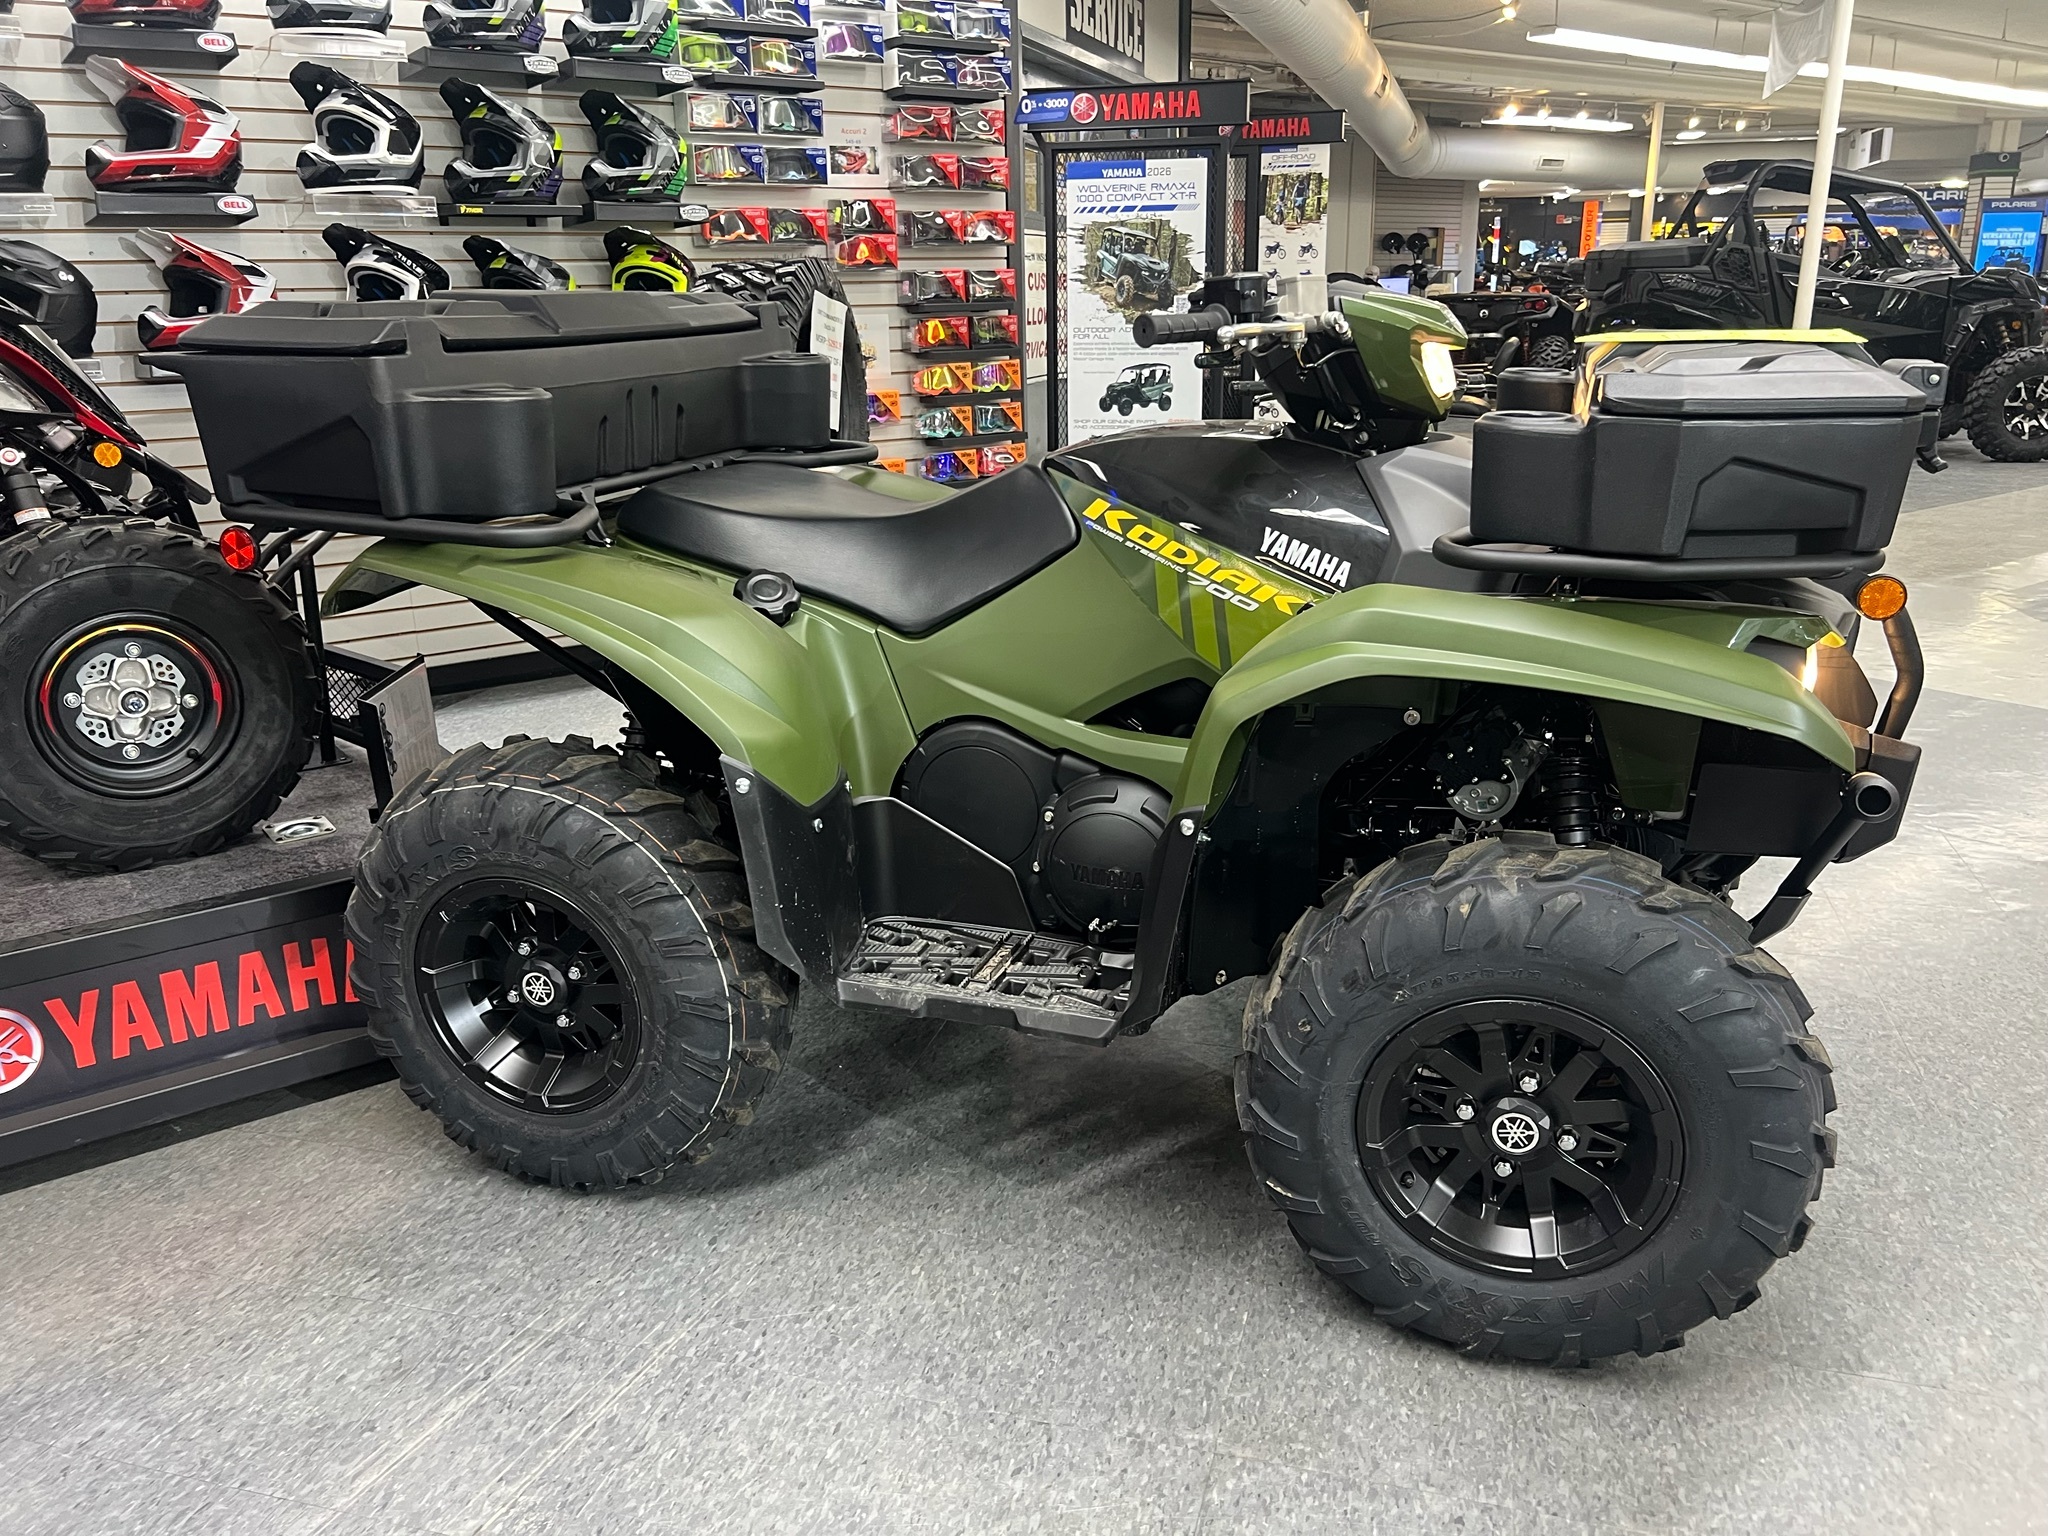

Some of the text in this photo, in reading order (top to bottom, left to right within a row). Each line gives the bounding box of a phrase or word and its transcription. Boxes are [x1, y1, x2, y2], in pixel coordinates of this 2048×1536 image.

[203, 38, 228, 47] BELL
[1100, 89, 1201, 121] YAMAHA
[1241, 117, 1311, 139] YAMAHA
[1272, 153, 1316, 161] OFF-ROAD
[1101, 166, 1171, 178] YAMAHA 2026
[1077, 181, 1196, 194] WOLVERINE RMAX4
[1919, 190, 1968, 200] LARI
[223, 201, 248, 209] BELL
[1076, 191, 1198, 203] 1000 COMPACT XT-R
[1082, 497, 1308, 616] KODIAK
[1260, 526, 1352, 588] YAMAHA
[1085, 520, 1261, 612] POWER STEERING 700
[1069, 862, 1144, 891] YAMAHA
[1389, 1248, 1666, 1325] MAXXIS
